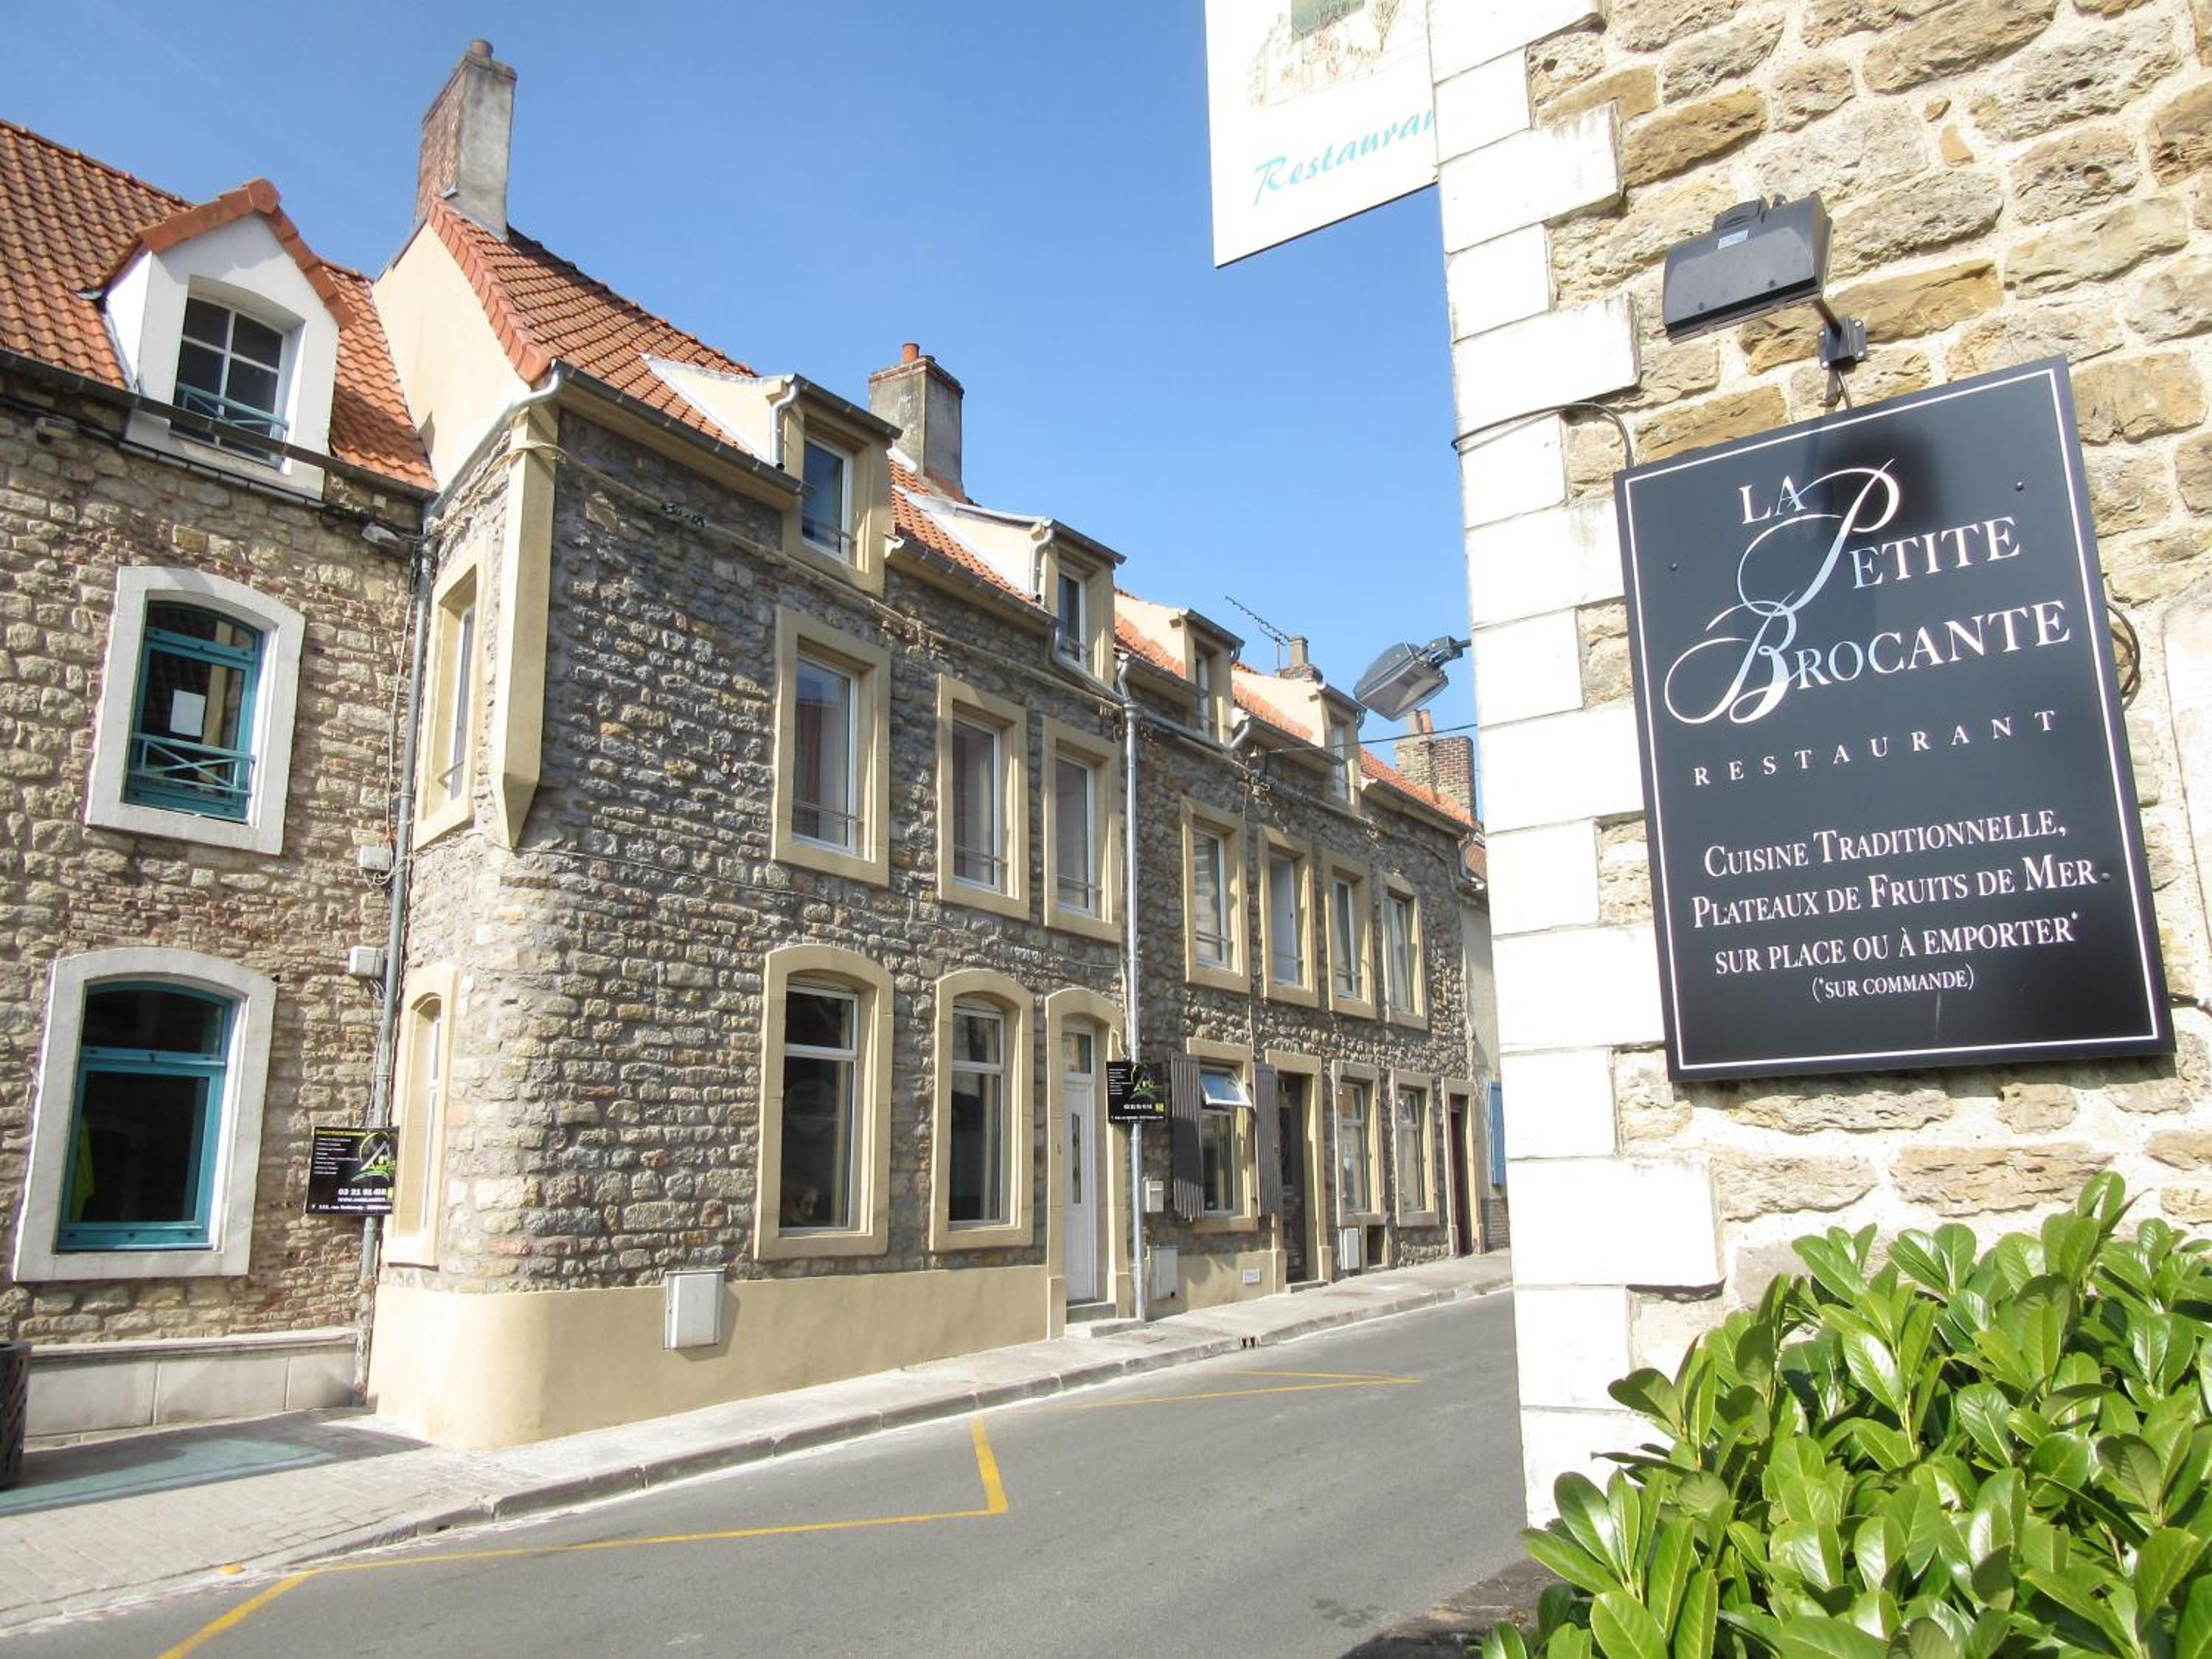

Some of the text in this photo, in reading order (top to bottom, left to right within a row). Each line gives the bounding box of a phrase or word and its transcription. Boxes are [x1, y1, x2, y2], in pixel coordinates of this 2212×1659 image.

[1738, 476, 1806, 524] LA
[1738, 458, 2020, 616] PETITE
[1664, 591, 2070, 724] BROCANTE
[1693, 710, 2056, 786] RESTAURANT
[1704, 810, 2065, 877] CUISINE TRADITIONNELLE,
[1691, 854, 2098, 928] PLATEAUX DE FRUITS DE MER
[1715, 948, 1762, 974] SUR
[1768, 939, 1846, 970] PLACE
[1853, 935, 1888, 961] OU
[1899, 927, 1916, 958] À
[1863, 963, 1974, 995] COMMANDE)
